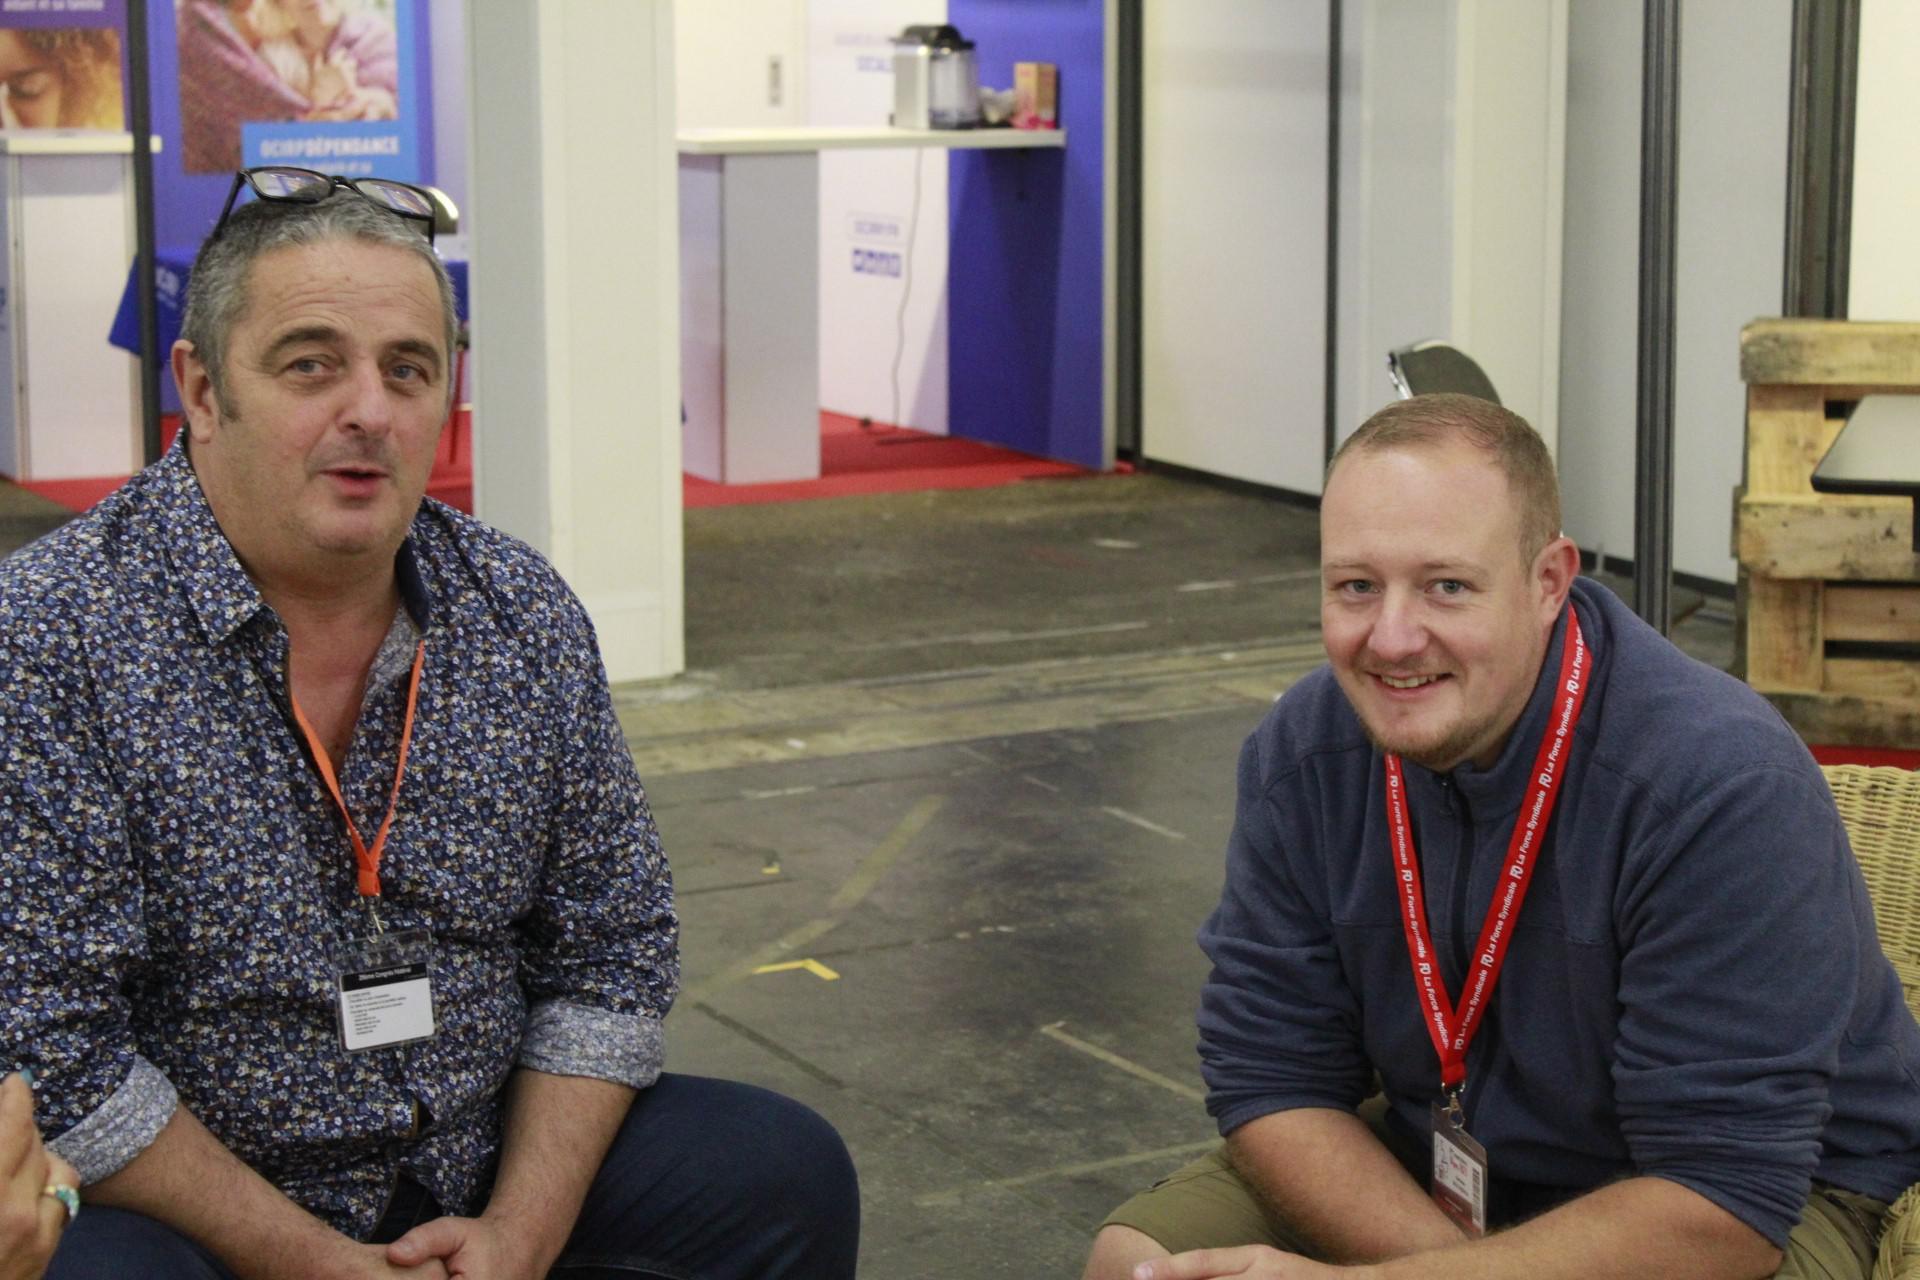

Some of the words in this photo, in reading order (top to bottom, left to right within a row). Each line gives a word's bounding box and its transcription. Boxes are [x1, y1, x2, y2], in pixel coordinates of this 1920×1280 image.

[1573, 645, 1584, 669] Force
[1571, 668, 1581, 680] La
[1548, 737, 1563, 762] Force
[1544, 761, 1555, 774] La
[1519, 830, 1534, 854] Force
[1516, 853, 1526, 865] La
[1490, 920, 1504, 944] Force
[1486, 943, 1497, 954] La
